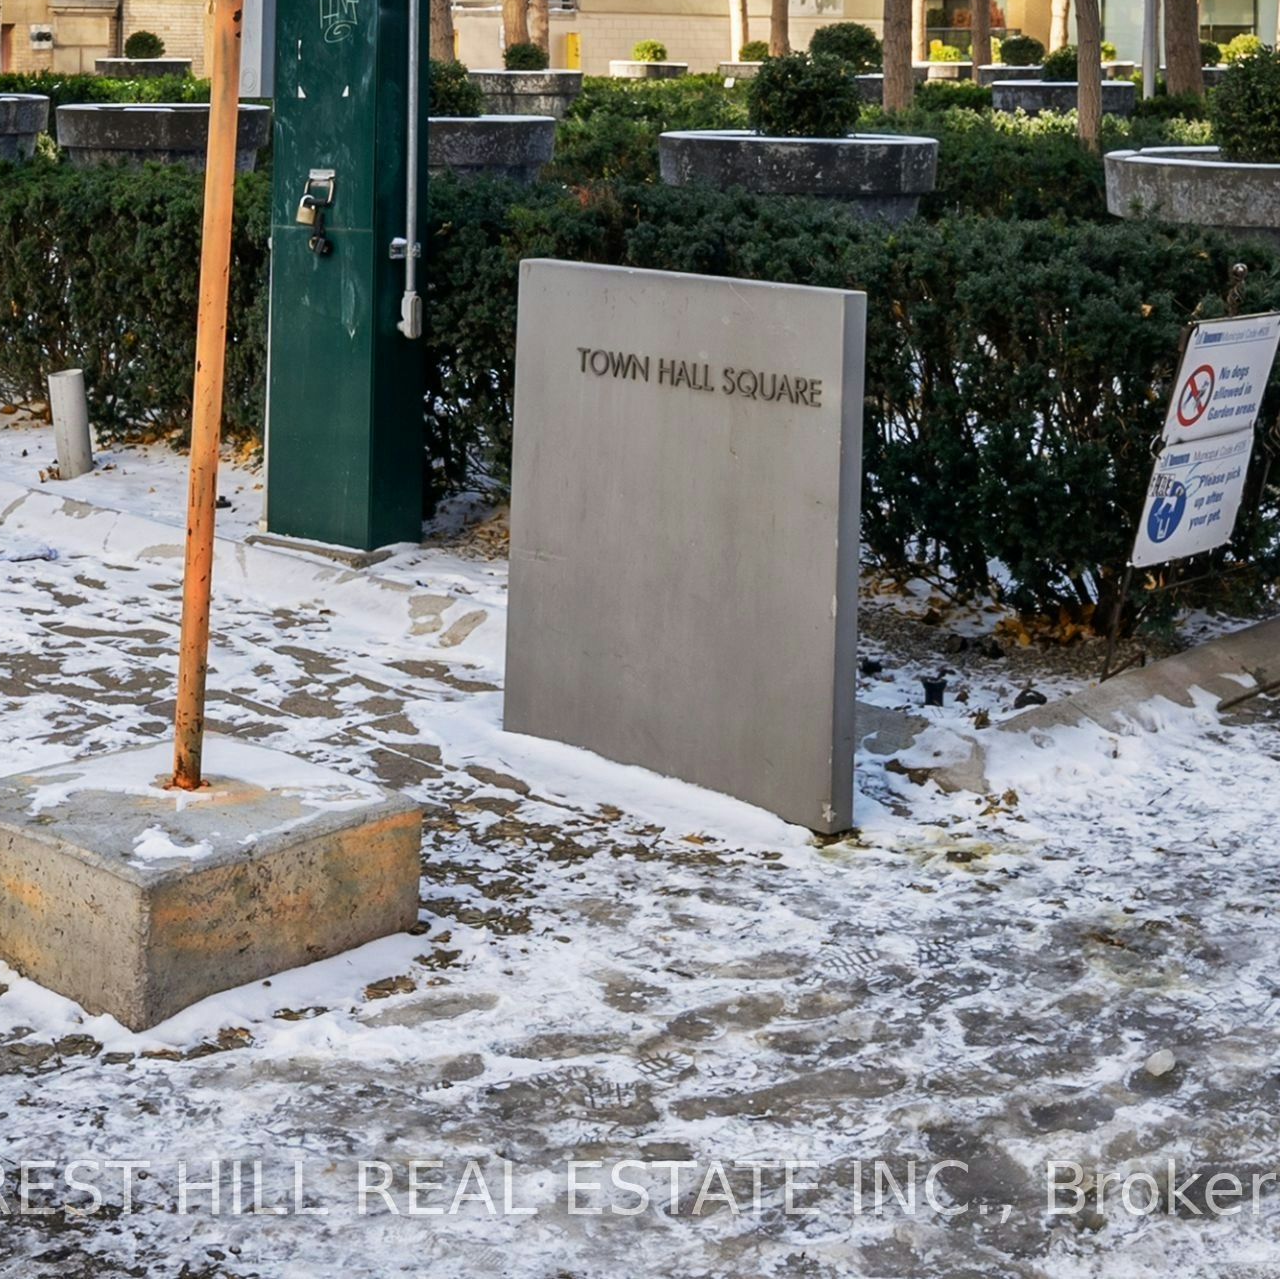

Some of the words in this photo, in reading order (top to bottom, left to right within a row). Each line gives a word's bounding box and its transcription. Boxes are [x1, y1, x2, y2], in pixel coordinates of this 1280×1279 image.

[577, 347, 650, 383] TOWN
[657, 358, 715, 392] HALL
[722, 367, 823, 408] SQUARE
[1218, 366, 1231, 380] No
[1231, 364, 1250, 381] dogs
[1212, 382, 1246, 401] allowed
[1244, 382, 1253, 396] in
[1207, 404, 1235, 421] Garden
[1199, 472, 1226, 488] Please
[1225, 465, 1241, 485] pick
[1194, 496, 1205, 511] up
[1205, 491, 1225, 505] after
[1188, 514, 1208, 531] your
